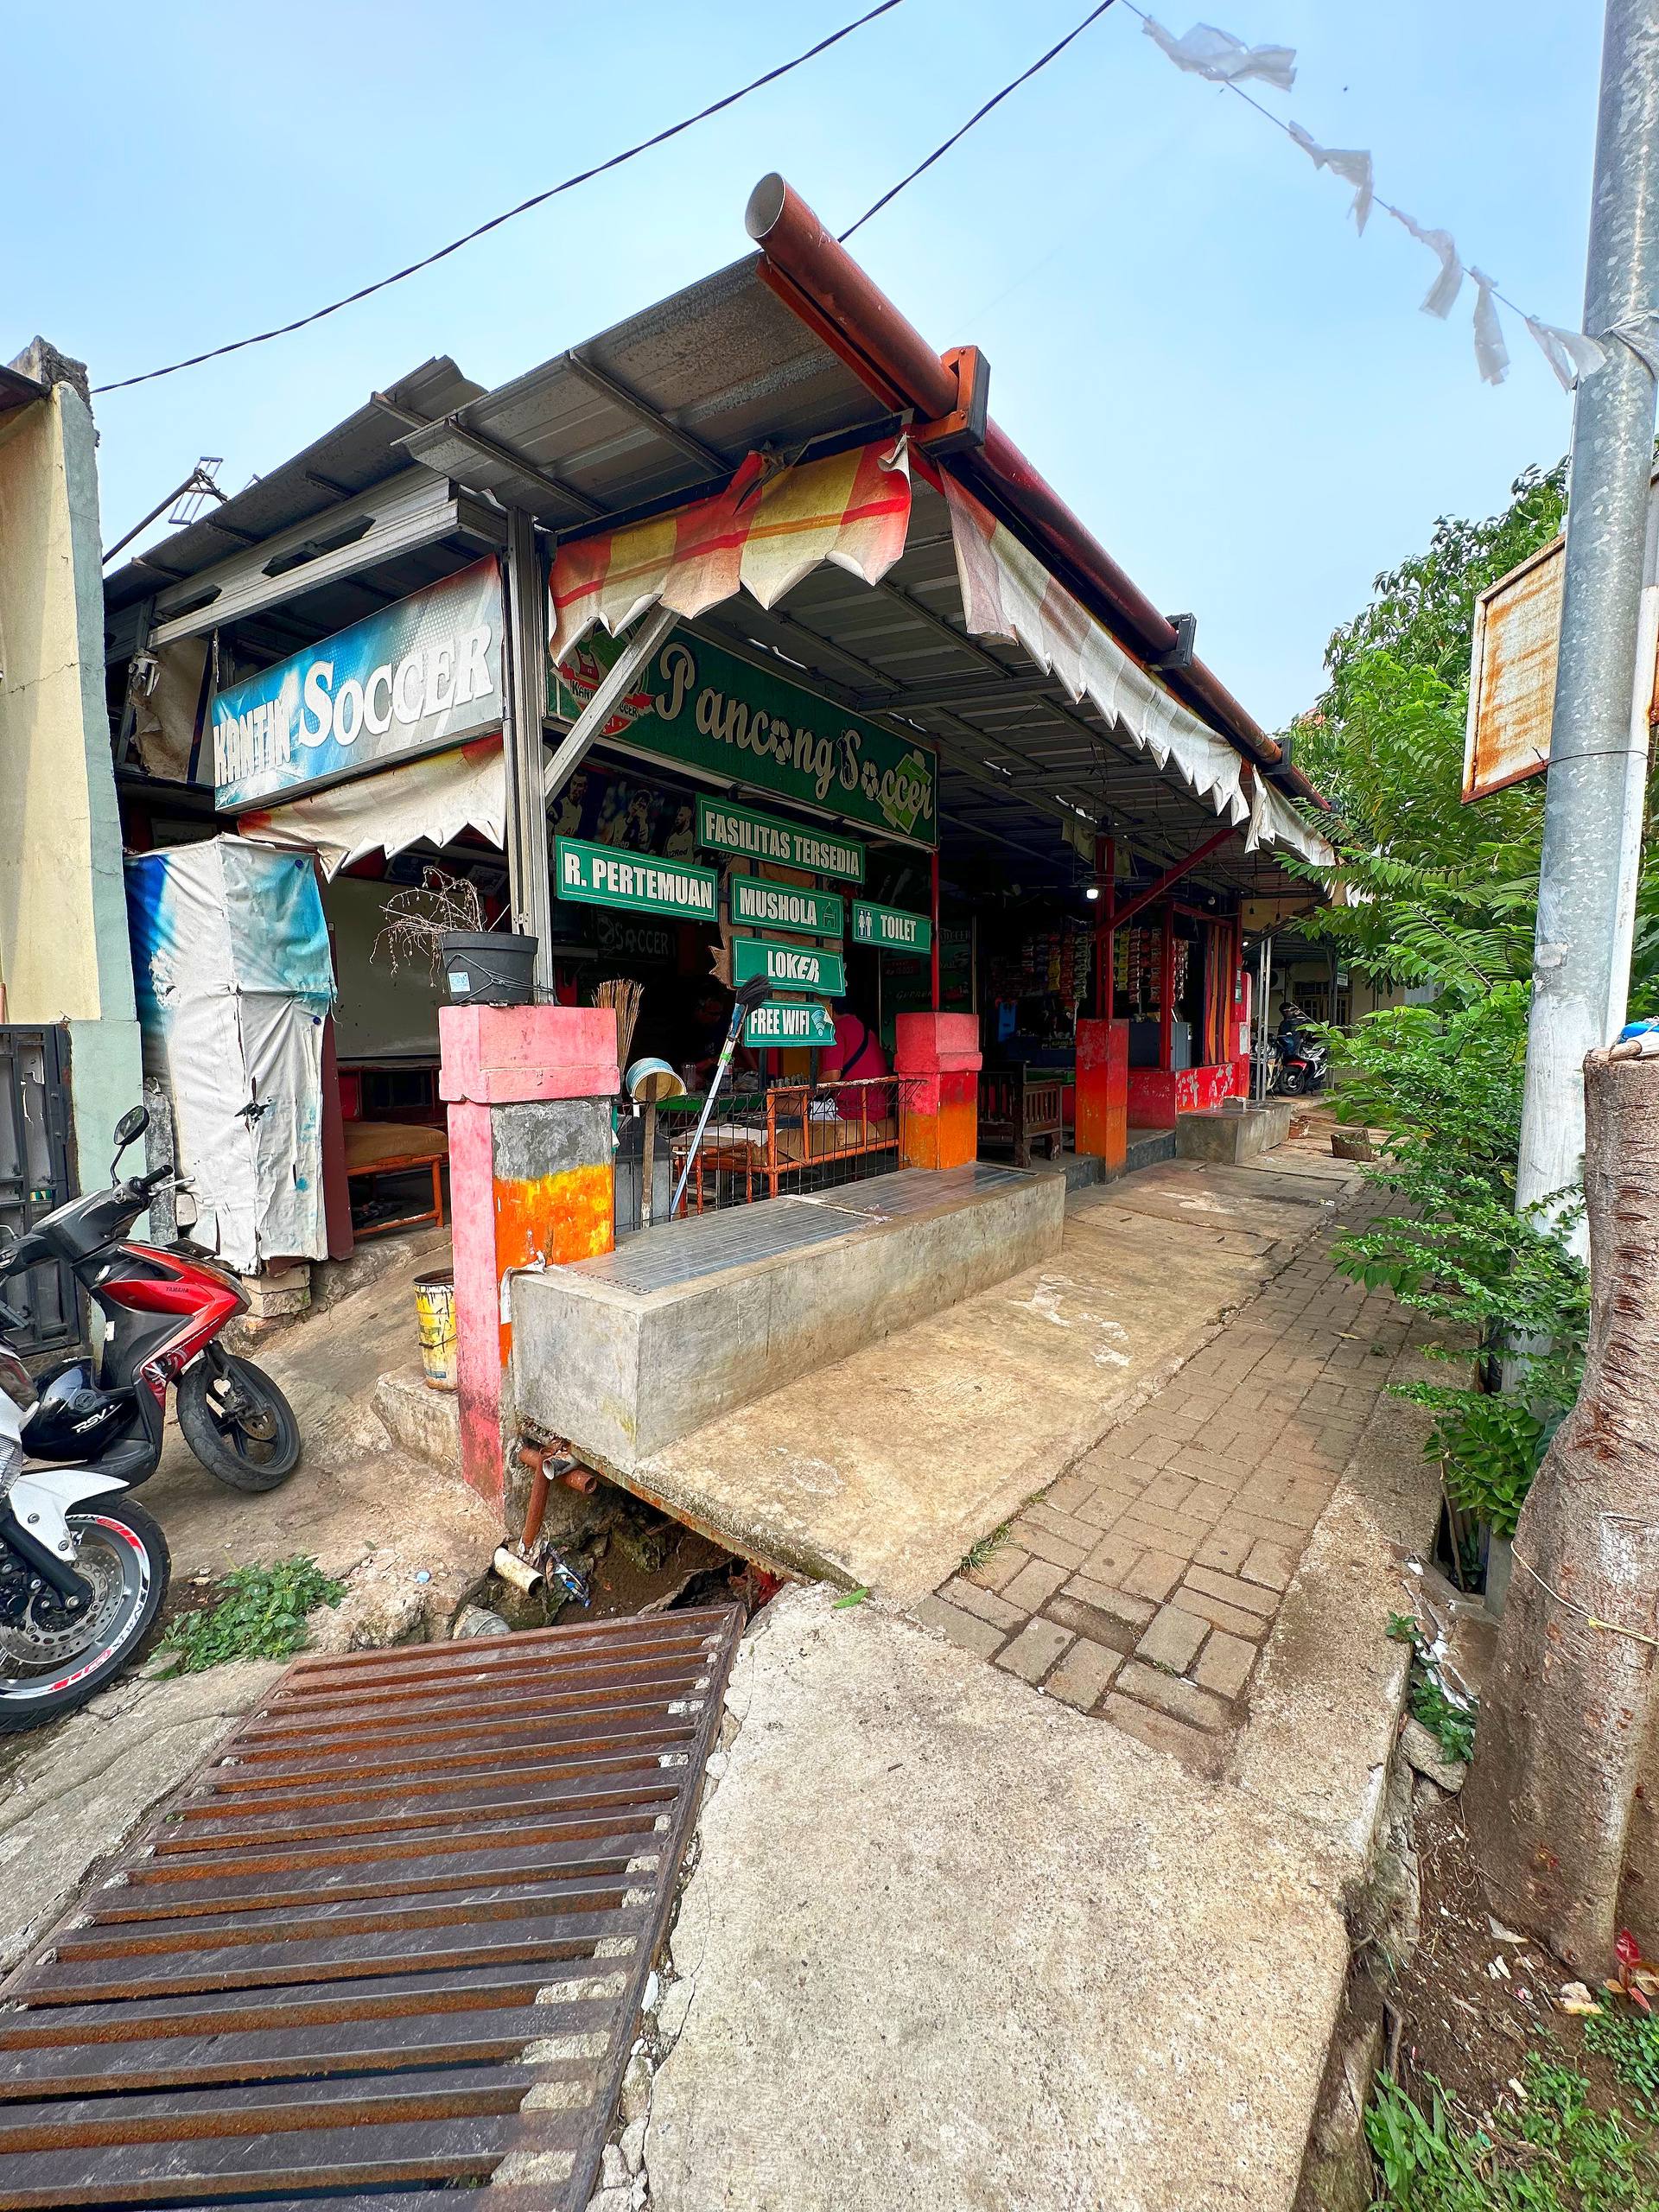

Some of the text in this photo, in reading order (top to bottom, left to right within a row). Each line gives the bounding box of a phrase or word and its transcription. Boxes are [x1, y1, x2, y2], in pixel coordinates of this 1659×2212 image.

[213, 624, 493, 787] KANTIN SOCCER
[656, 642, 933, 820] Pancong Soccer
[705, 811, 860, 876] FASILITAS TERSEDIA
[564, 852, 713, 909] R. PERTEMUAN
[740, 887, 817, 925] MUSHOLA
[880, 914, 917, 942] TOILET
[767, 950, 821, 983] LOKER
[750, 1007, 810, 1035] FREE WIFI
[72, 1408, 107, 1433] RSV
